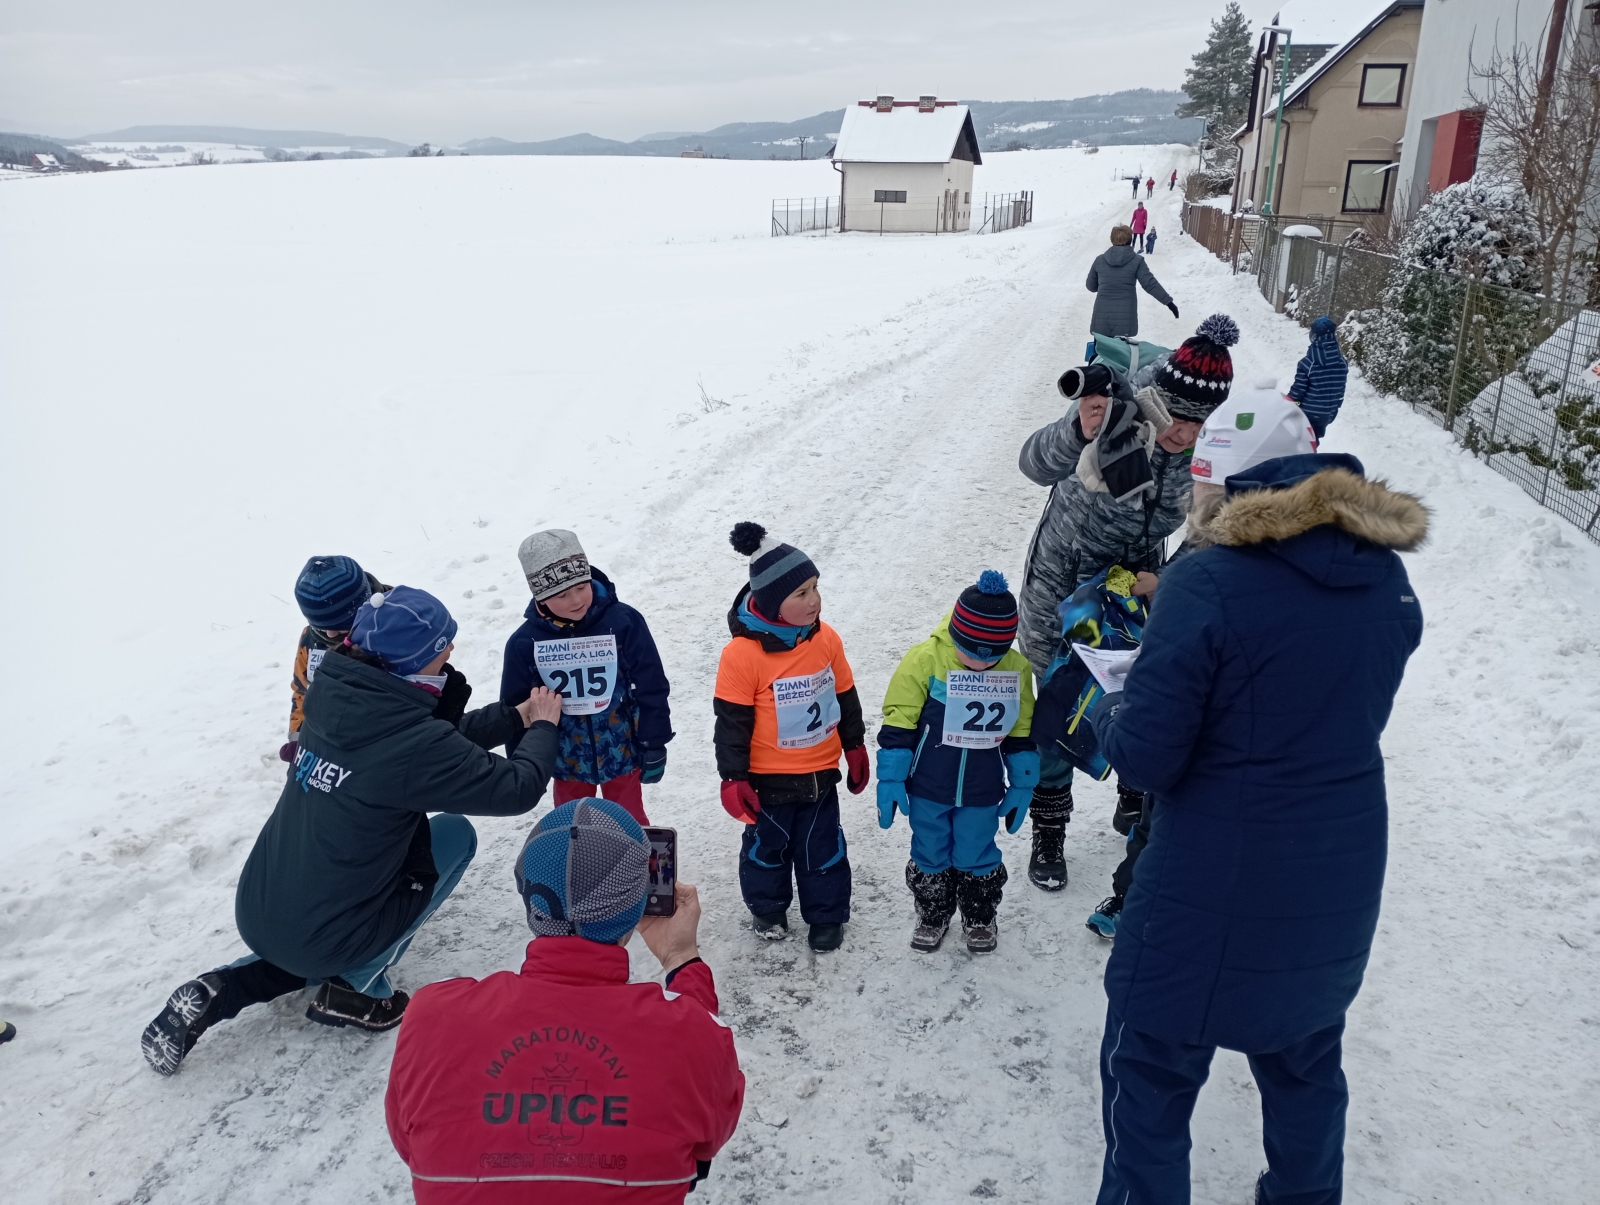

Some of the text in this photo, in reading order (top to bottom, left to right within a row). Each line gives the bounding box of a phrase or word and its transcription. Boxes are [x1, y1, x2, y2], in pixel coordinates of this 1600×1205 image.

[537, 641, 570, 654] ZIMNÍ
[537, 649, 614, 663] BĚŽECKÁ LIGA
[548, 665, 608, 699] 215
[776, 677, 810, 692] ZIMNÍ
[950, 672, 985, 683] ZIMNÍ
[950, 682, 999, 694] BĚŽECKÁ
[806, 701, 823, 733] 2
[962, 700, 1006, 732] 22
[307, 776, 332, 793] NÁCHOD
[485, 1026, 629, 1080] MARATONSTAV
[554, 1052, 569, 1064] TJ
[480, 1152, 628, 1171] CZECH REPUBLIC
